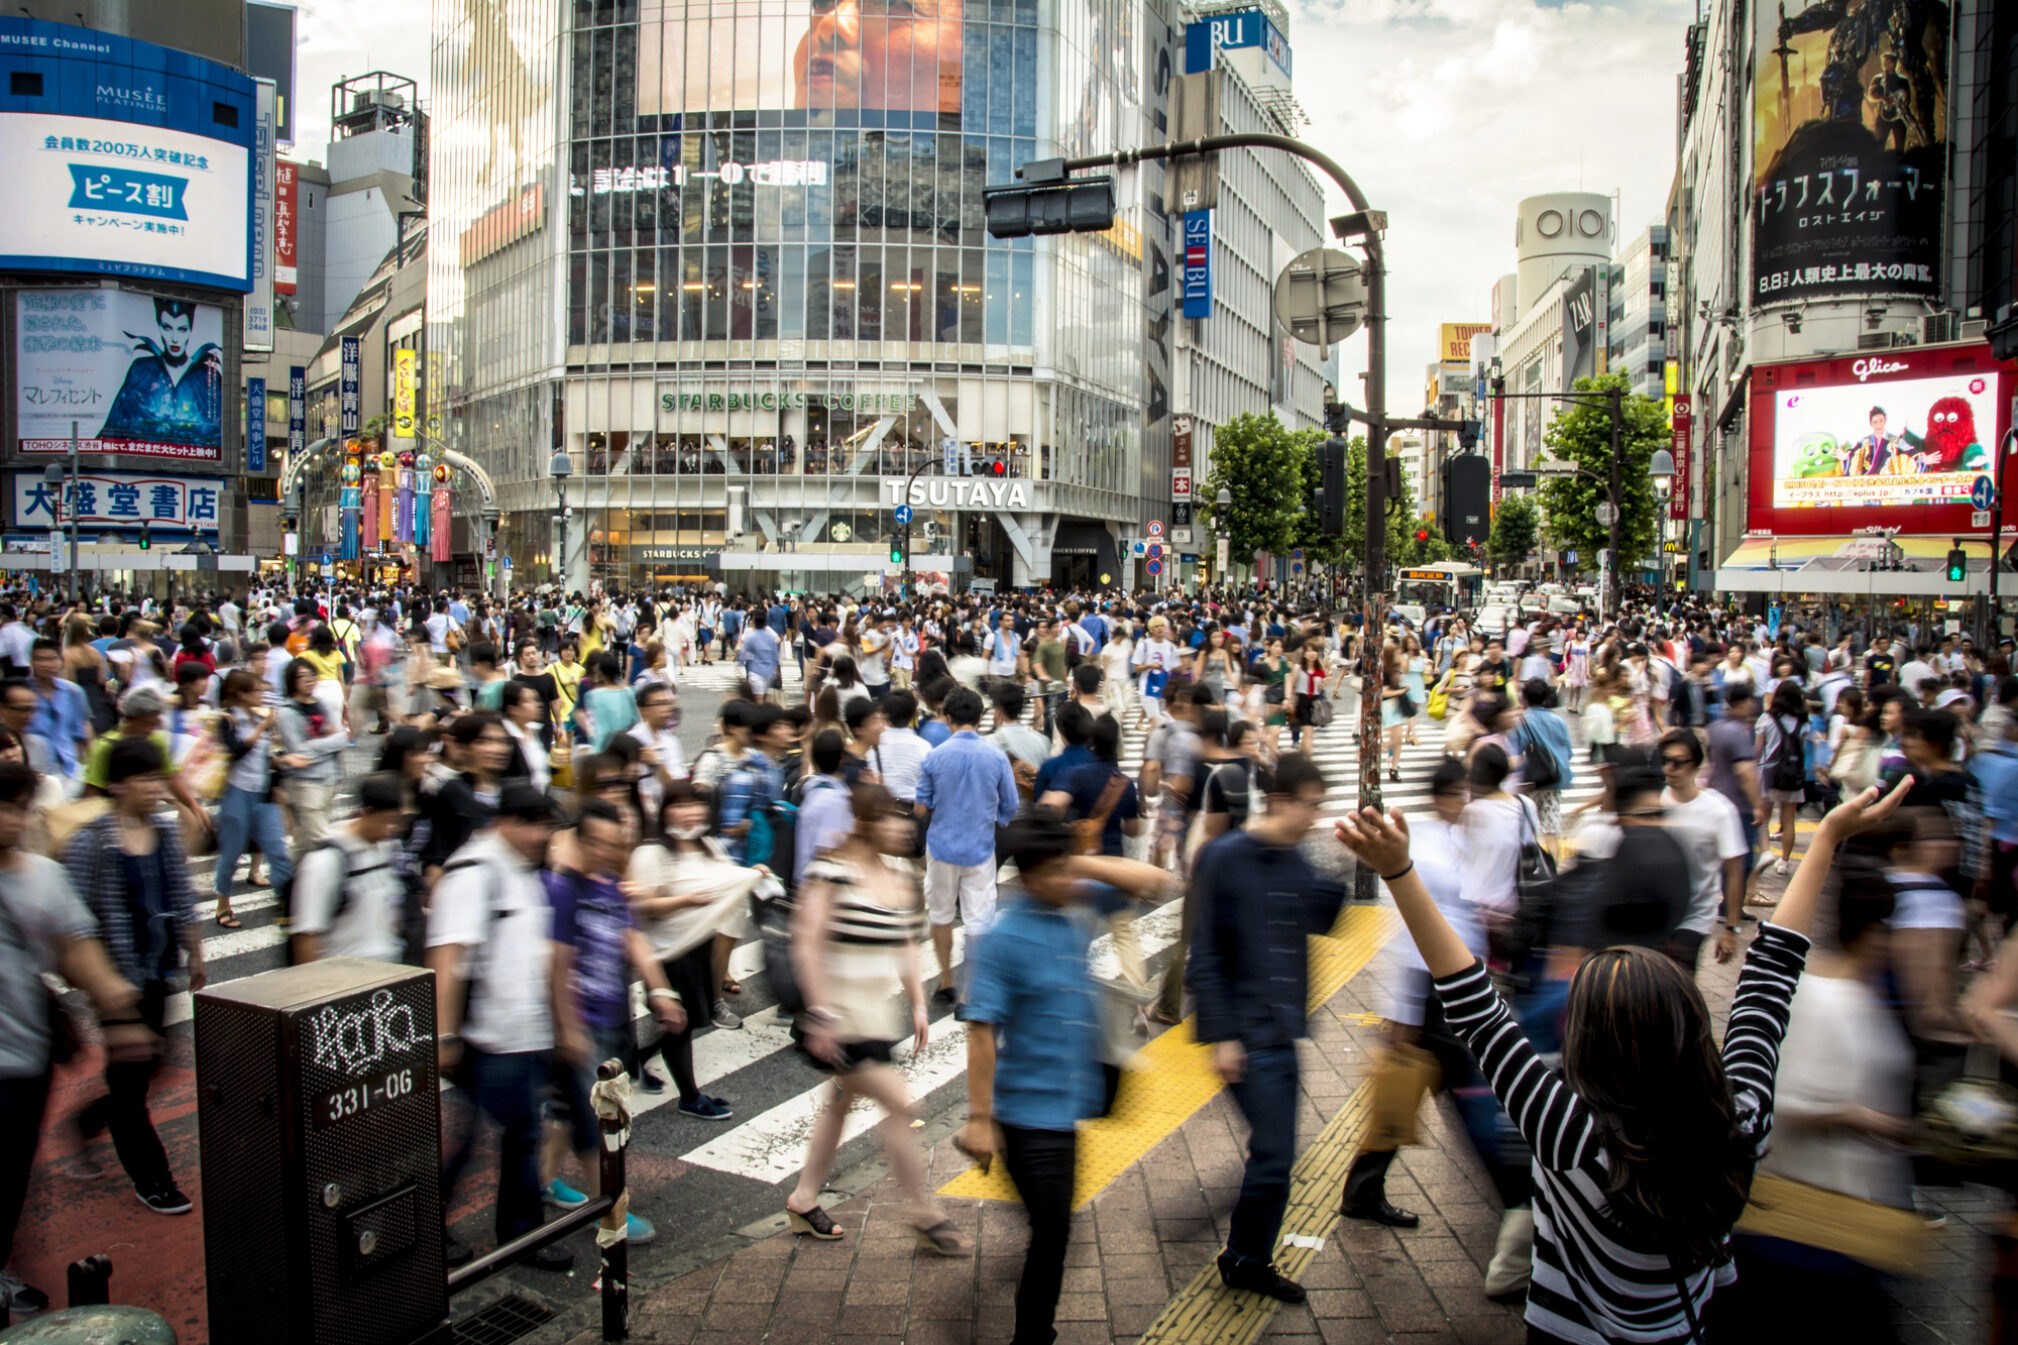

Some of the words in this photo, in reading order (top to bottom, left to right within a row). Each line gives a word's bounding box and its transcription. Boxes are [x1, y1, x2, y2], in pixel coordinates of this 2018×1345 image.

[1, 35, 48, 47] MUSEE
[52, 38, 110, 53] Channel
[96, 96, 167, 113] PLATINUM
[44, 135, 209, 169] 会員数200万人突破記念
[85, 174, 173, 208] ピース割
[1761, 168, 1935, 226] トランスフォーマー
[1799, 210, 1885, 228] ロストエイジ
[1186, 219, 1207, 298] SEIBU
[1759, 273, 1781, 293] 8.8
[1791, 262, 1933, 286] 人類史上最大の興奮。
[1569, 288, 1593, 332] ZAR
[1852, 358, 1909, 381] Glico
[23, 386, 102, 405] マレフィセント
[342, 342, 358, 430] 洋服の青山
[661, 392, 807, 411] STARBUCKS
[823, 392, 917, 411] COFFEE
[26, 440, 100, 450] TOHOシネズ渋谷
[1675, 430, 1686, 512] 三菱東京UFJ銀行
[24, 481, 216, 519] 大盛堂書店
[886, 479, 1028, 508] TSUTAYA
[643, 550, 700, 559] STARBUCKS
[328, 1068, 413, 1121] 331-06
